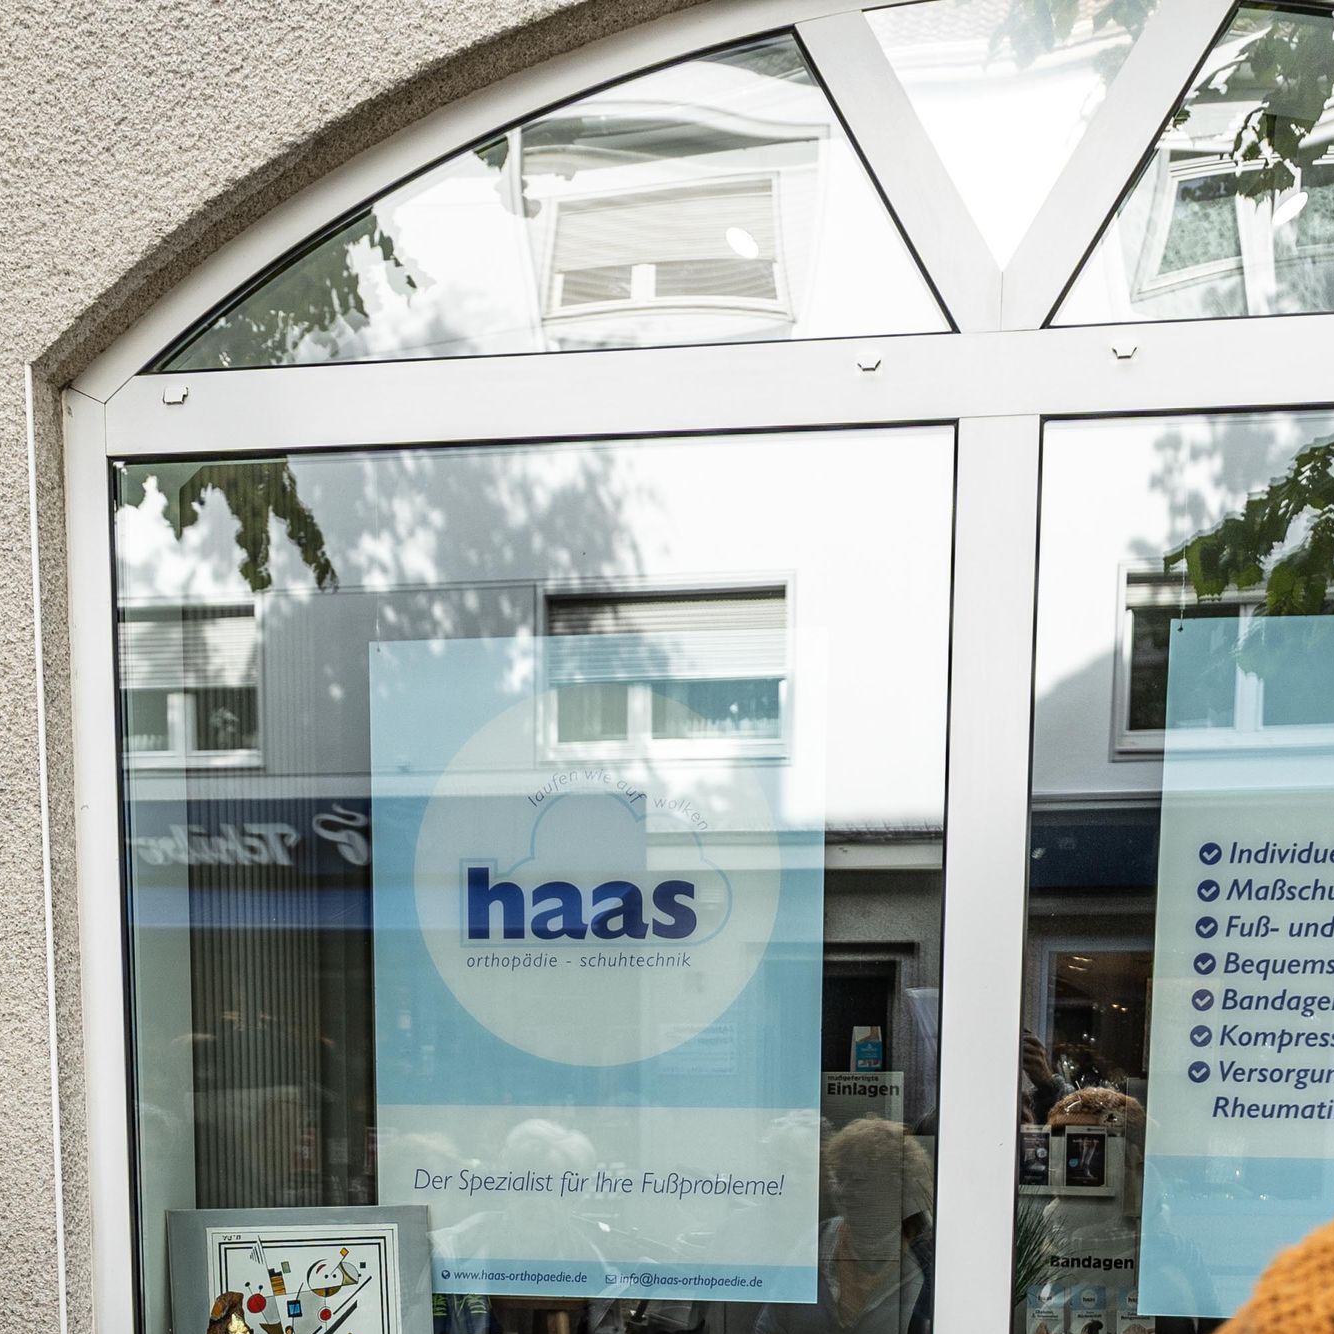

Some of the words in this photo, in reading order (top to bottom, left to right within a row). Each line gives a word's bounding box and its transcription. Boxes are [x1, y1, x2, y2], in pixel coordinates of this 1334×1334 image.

[527, 770, 578, 807] laufen
[585, 769, 612, 784] wie
[617, 779, 647, 803] auf
[654, 799, 708, 831] wolken
[467, 867, 698, 940] haas
[1225, 915, 1279, 938] Fuß-
[1288, 916, 1334, 938] und
[467, 952, 558, 972] orthopädie
[579, 952, 691, 968] schuhtechnik
[827, 1082, 900, 1098] Einlagen
[414, 1169, 452, 1191] Der
[459, 1170, 552, 1196] Spezialist
[561, 1172, 589, 1197] für
[596, 1172, 633, 1194] Ihre
[641, 1172, 785, 1200] Fußprobleme!
[1050, 1255, 1134, 1271] Bandagen
[454, 1269, 587, 1286] www.haas-orthopaedie.de
[619, 1272, 763, 1289] info@haas-orthopaedie.de
